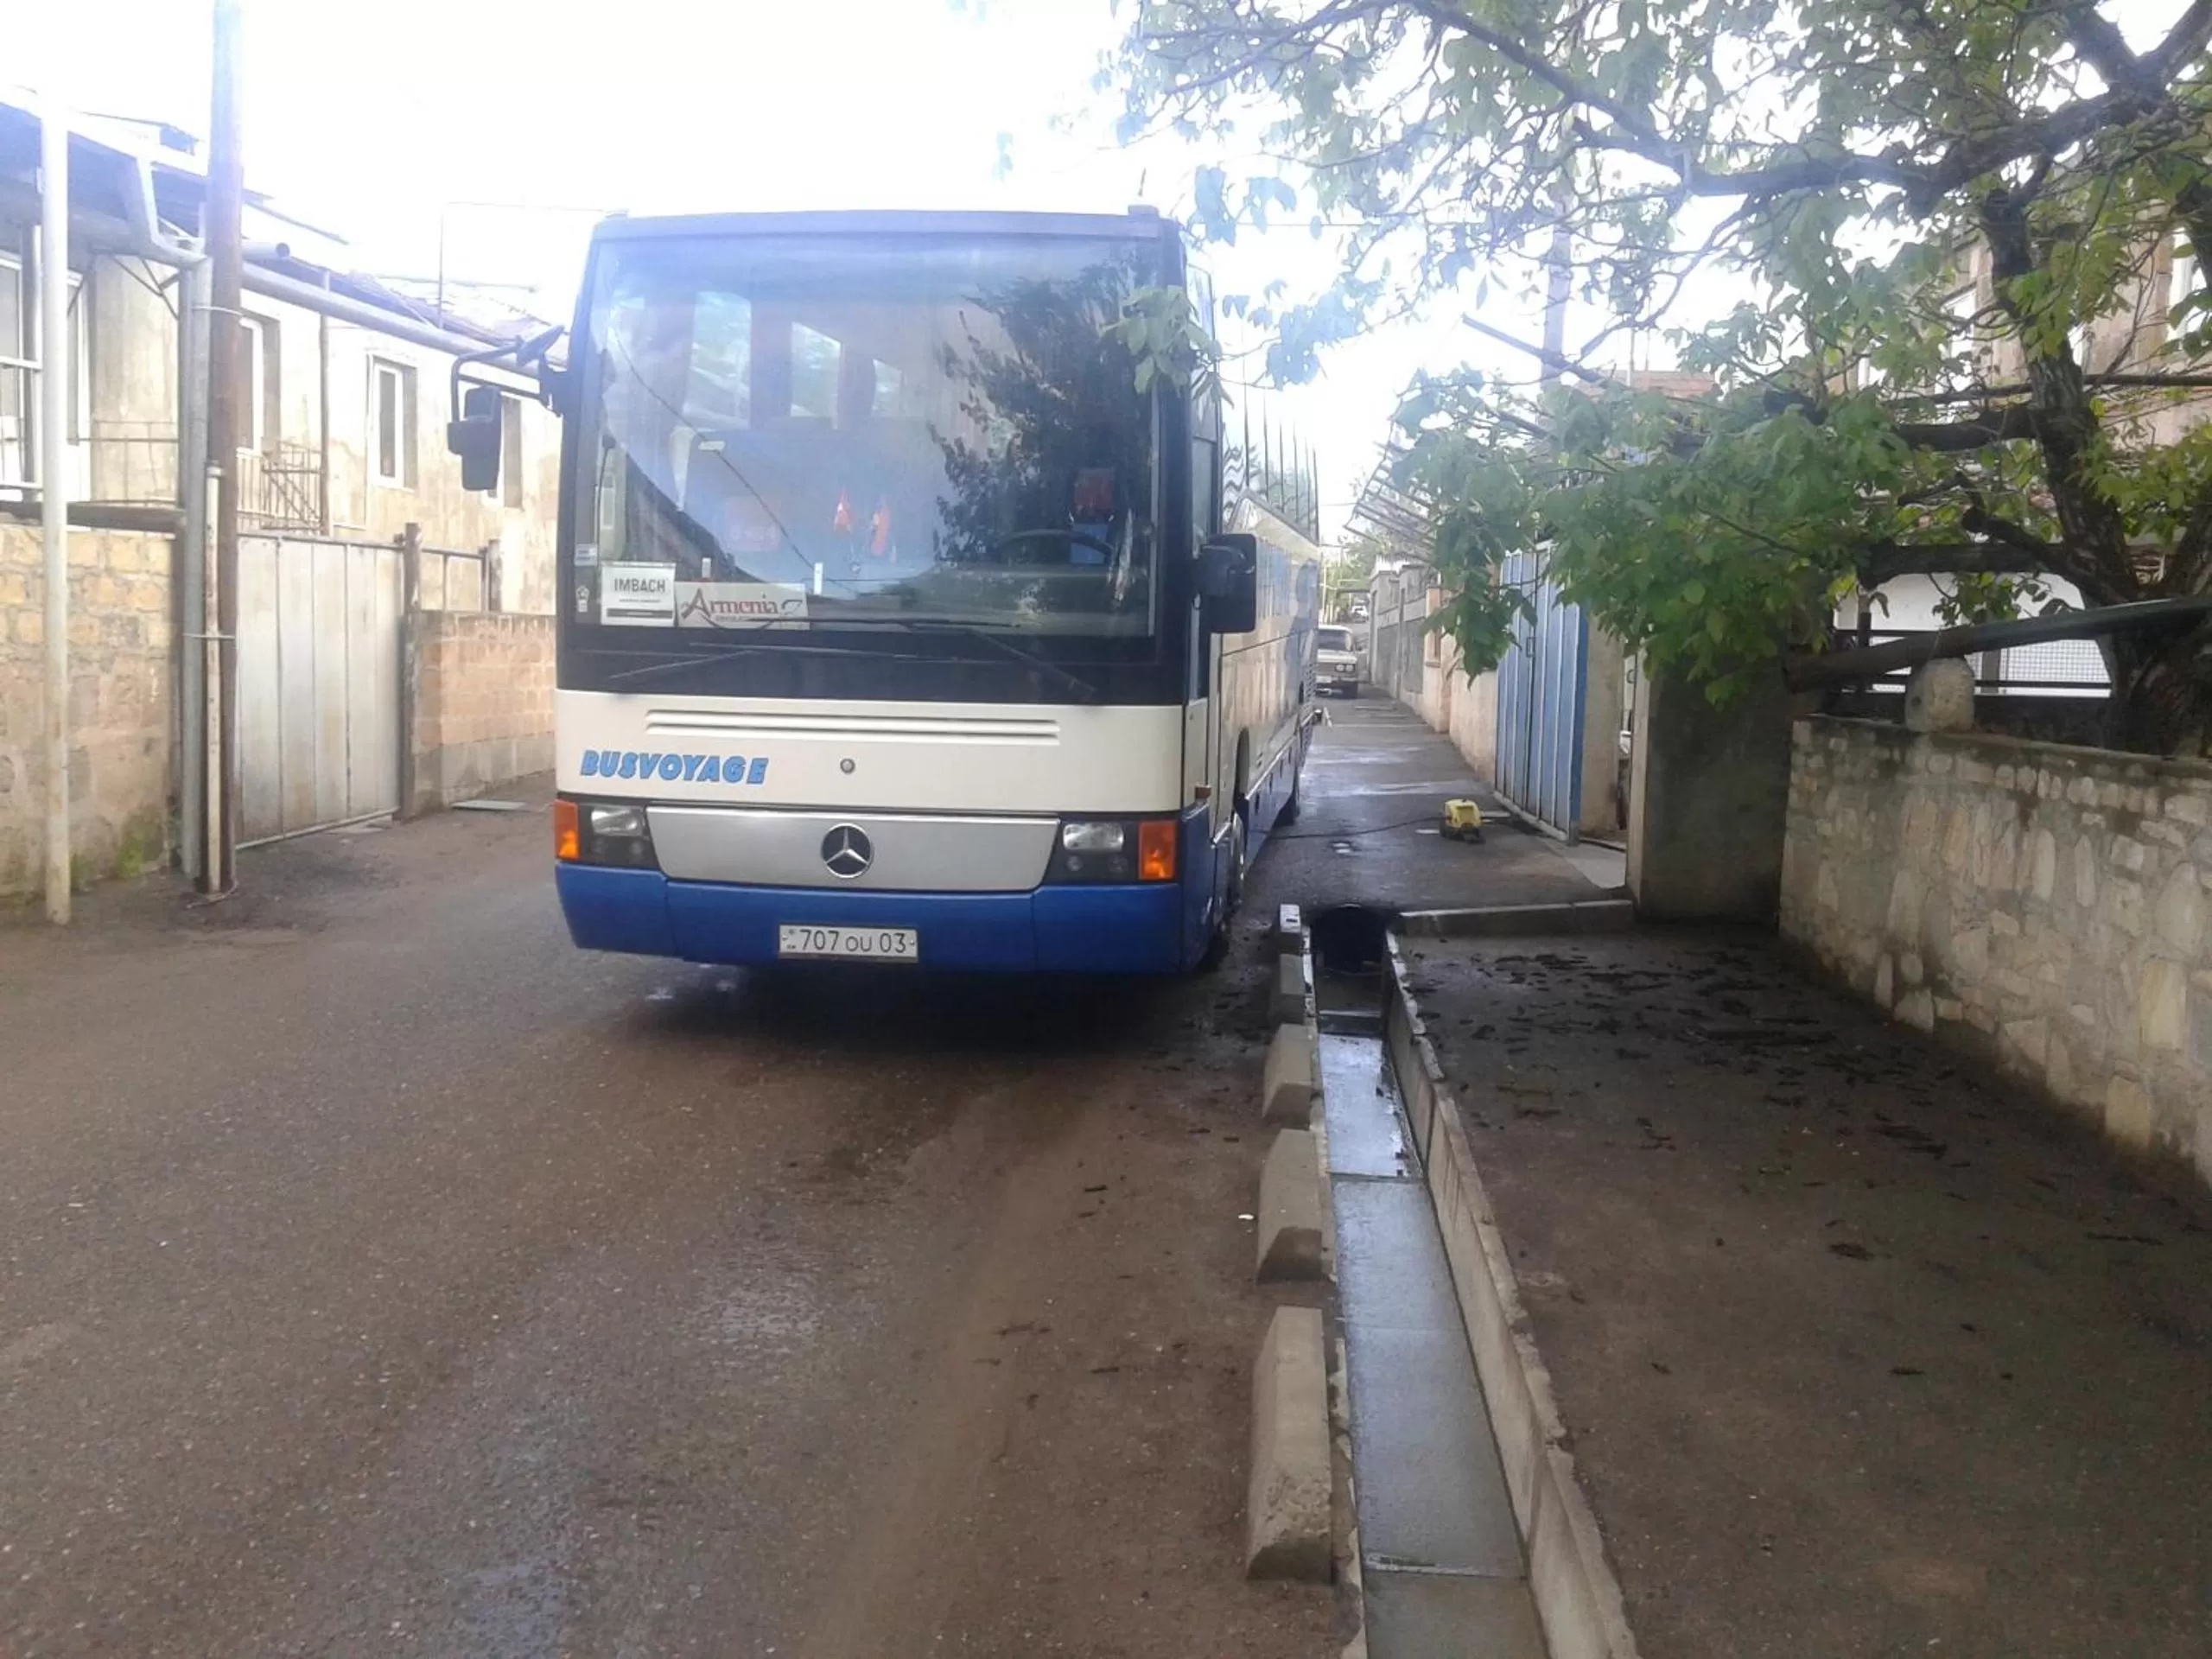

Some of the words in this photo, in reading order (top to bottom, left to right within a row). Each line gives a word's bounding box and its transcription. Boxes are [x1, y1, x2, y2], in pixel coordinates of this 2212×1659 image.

[613, 577, 666, 594] IMBACH
[681, 588, 779, 620] Armenia
[580, 749, 769, 785] BUSVOYAGE
[799, 928, 840, 951] 707
[879, 931, 907, 954] 03
